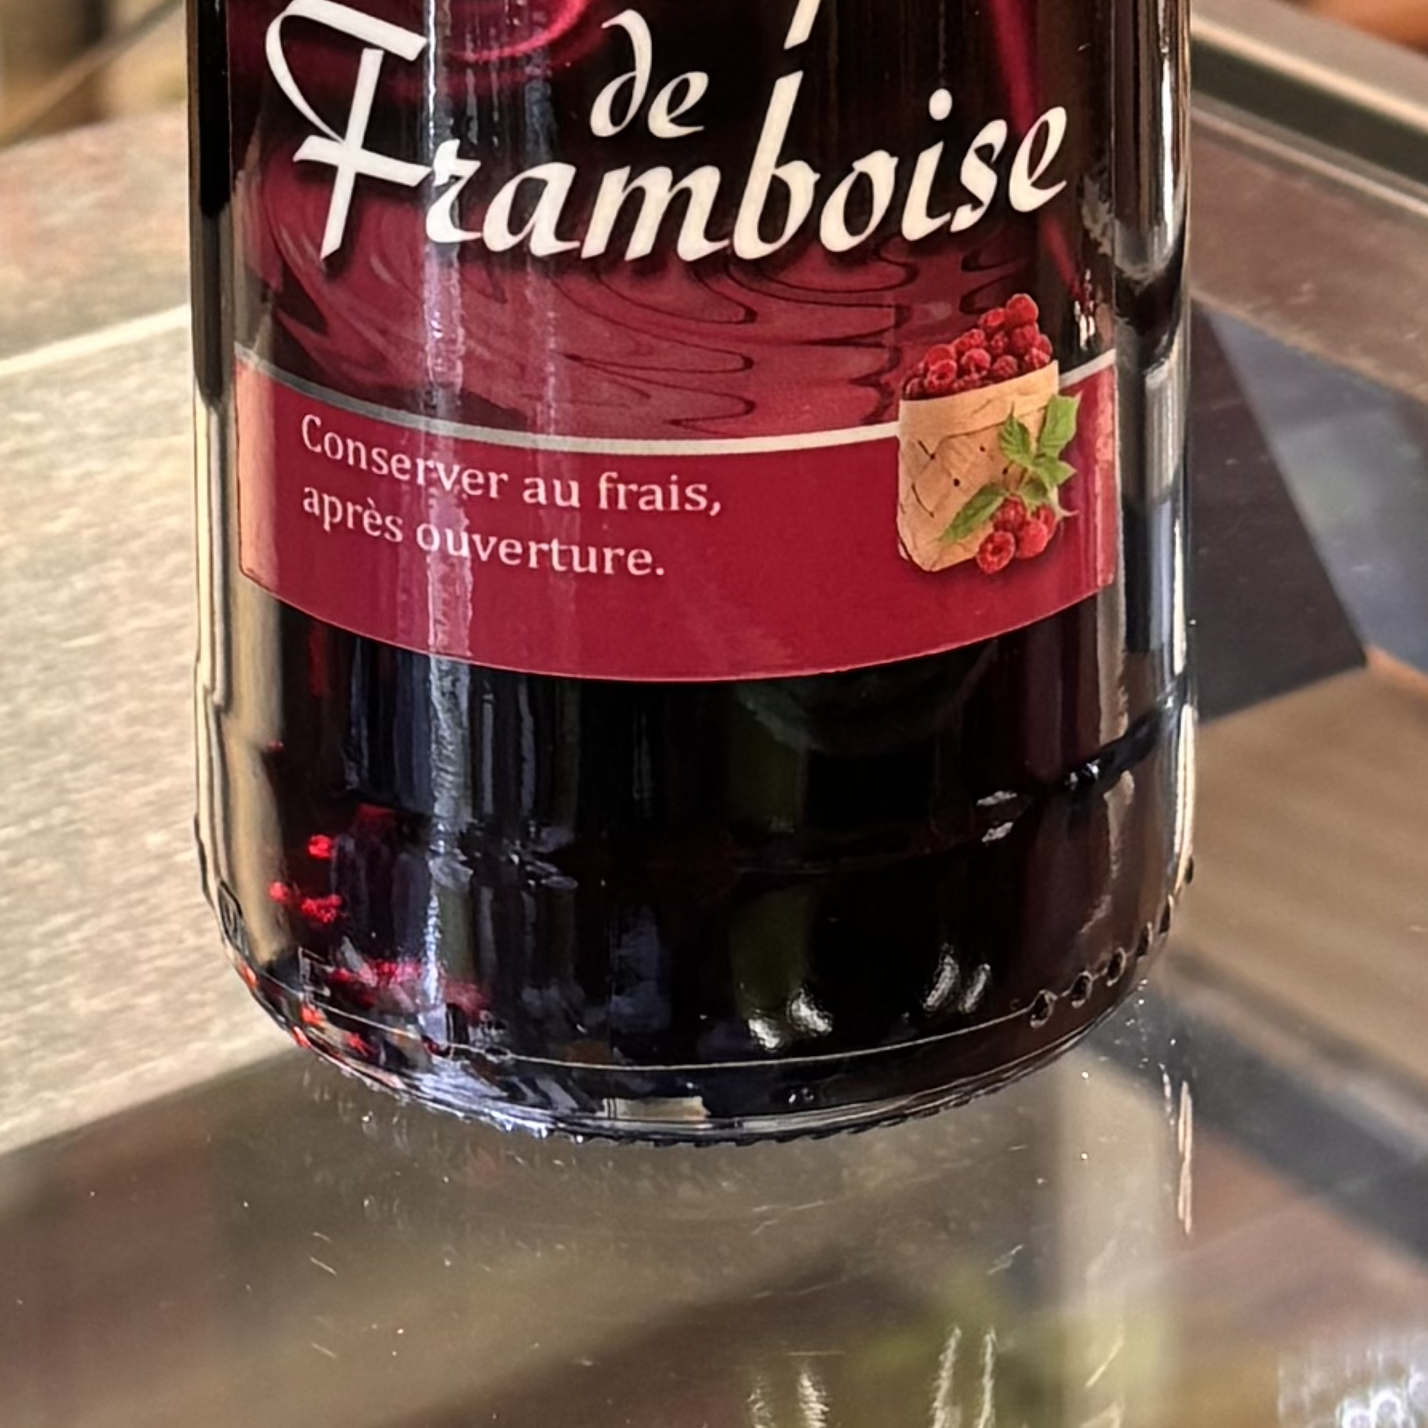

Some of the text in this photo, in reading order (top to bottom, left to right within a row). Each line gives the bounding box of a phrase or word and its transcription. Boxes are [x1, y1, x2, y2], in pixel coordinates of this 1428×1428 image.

[590, 10, 710, 139] de
[301, 414, 723, 517] Conserver au frais,
[302, 483, 666, 578] après ouverture.
